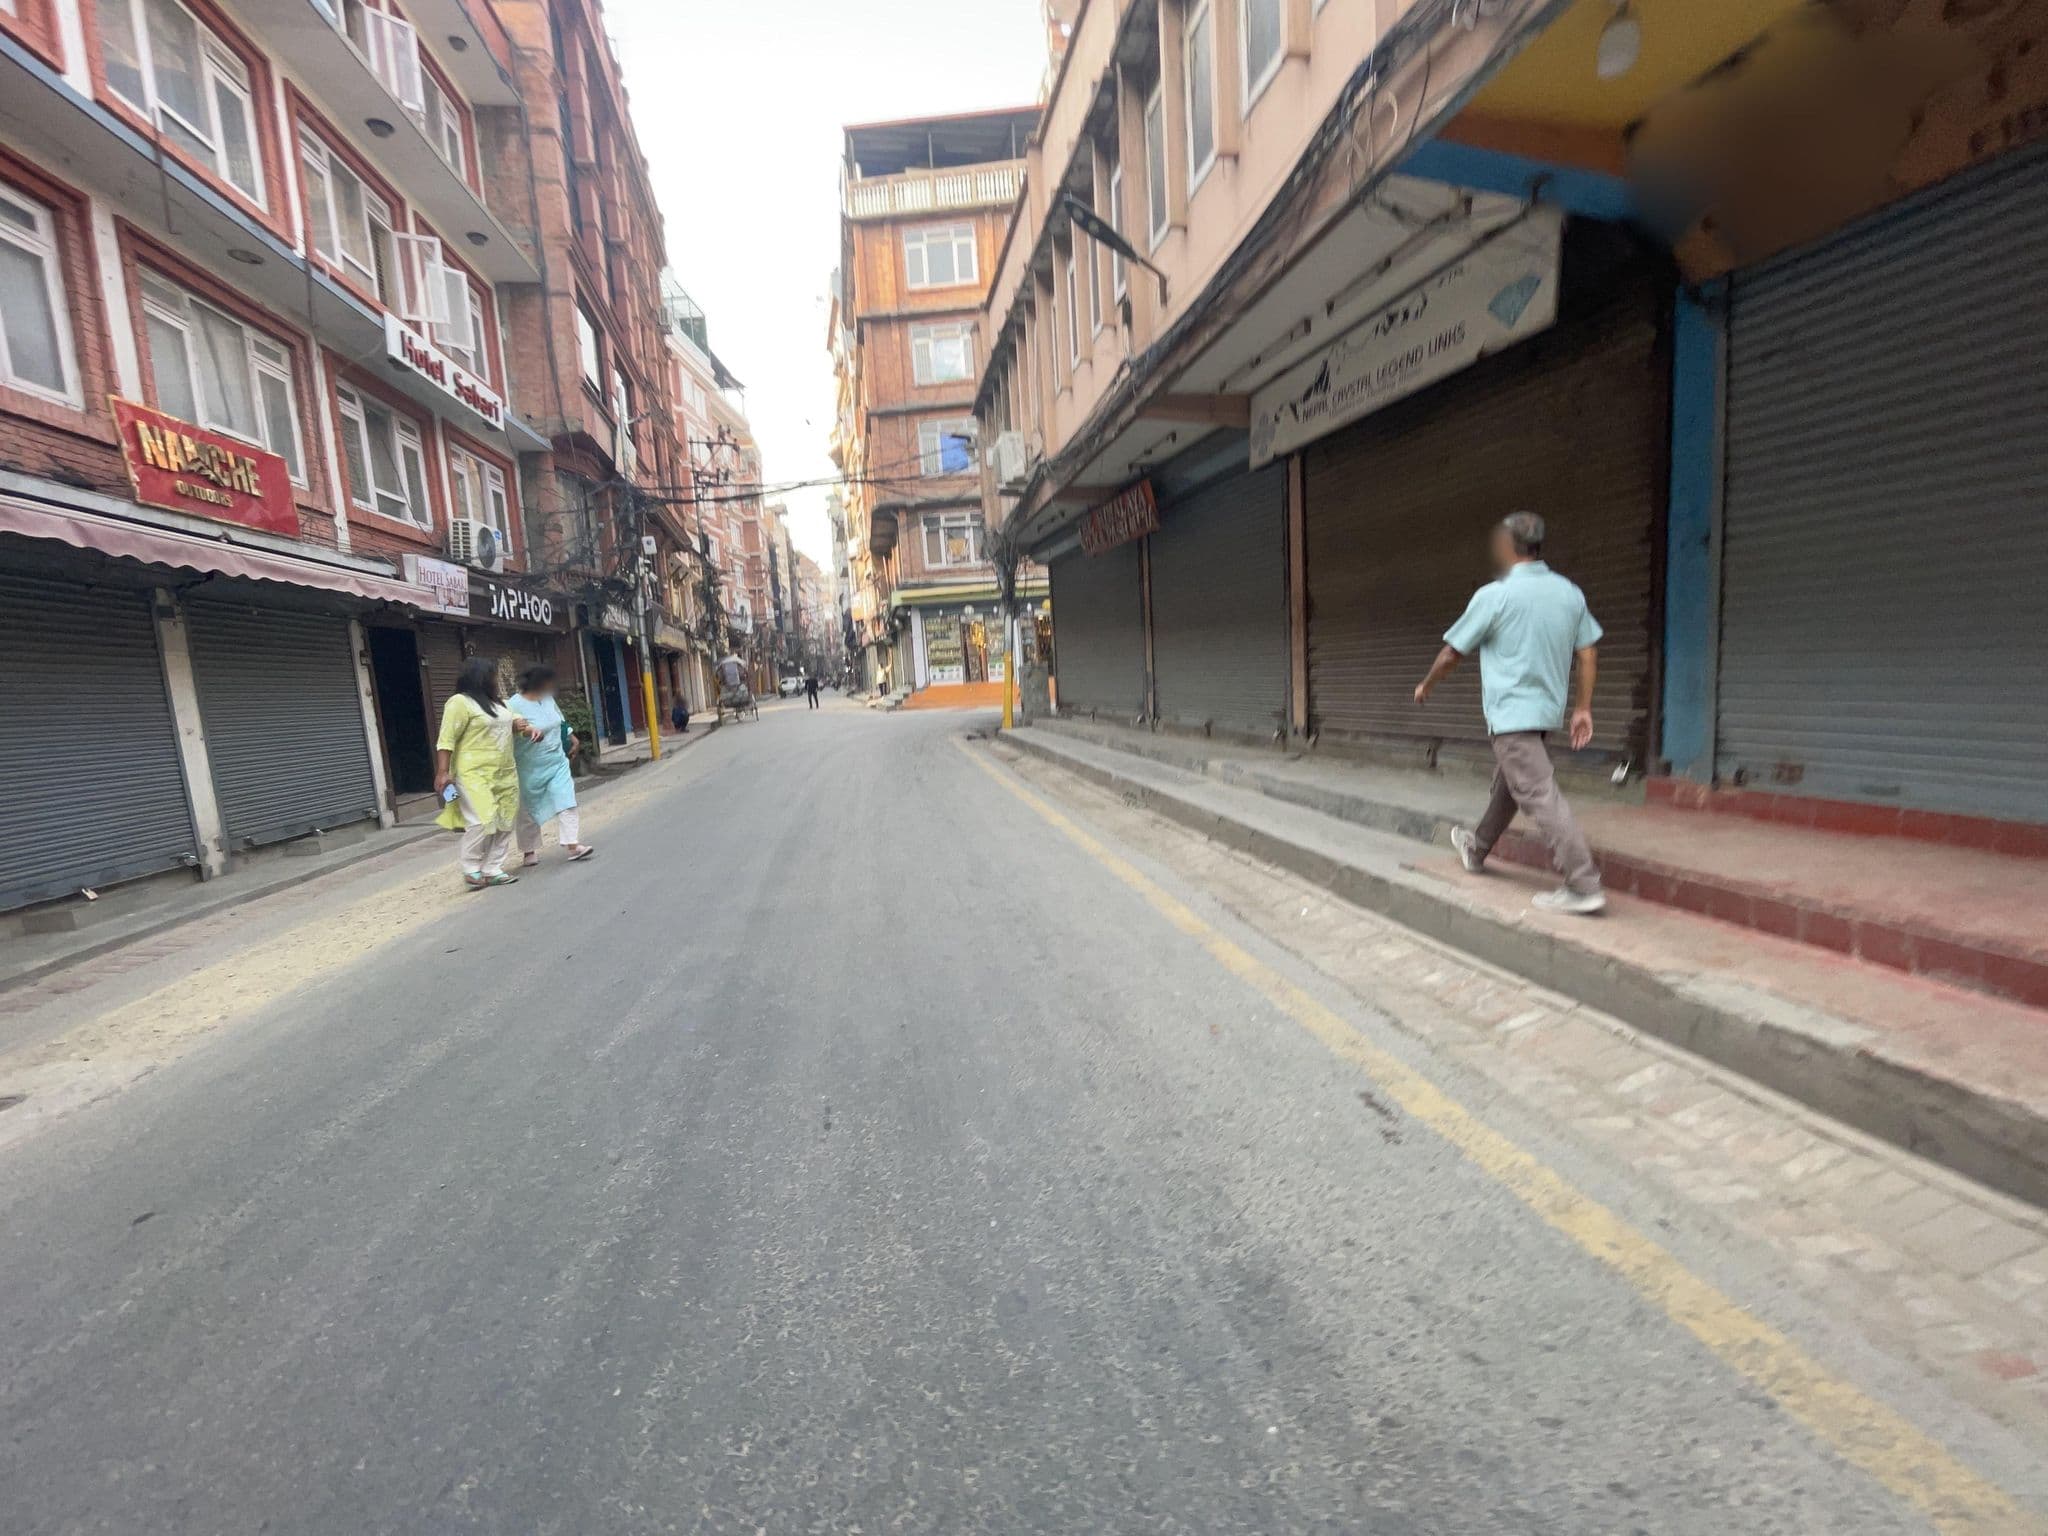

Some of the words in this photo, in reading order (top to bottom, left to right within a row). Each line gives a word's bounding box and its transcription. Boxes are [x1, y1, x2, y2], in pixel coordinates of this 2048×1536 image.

[400, 330, 446, 386] Hotel
[453, 372, 500, 422] Sabari
[418, 566, 444, 586] HOTEL
